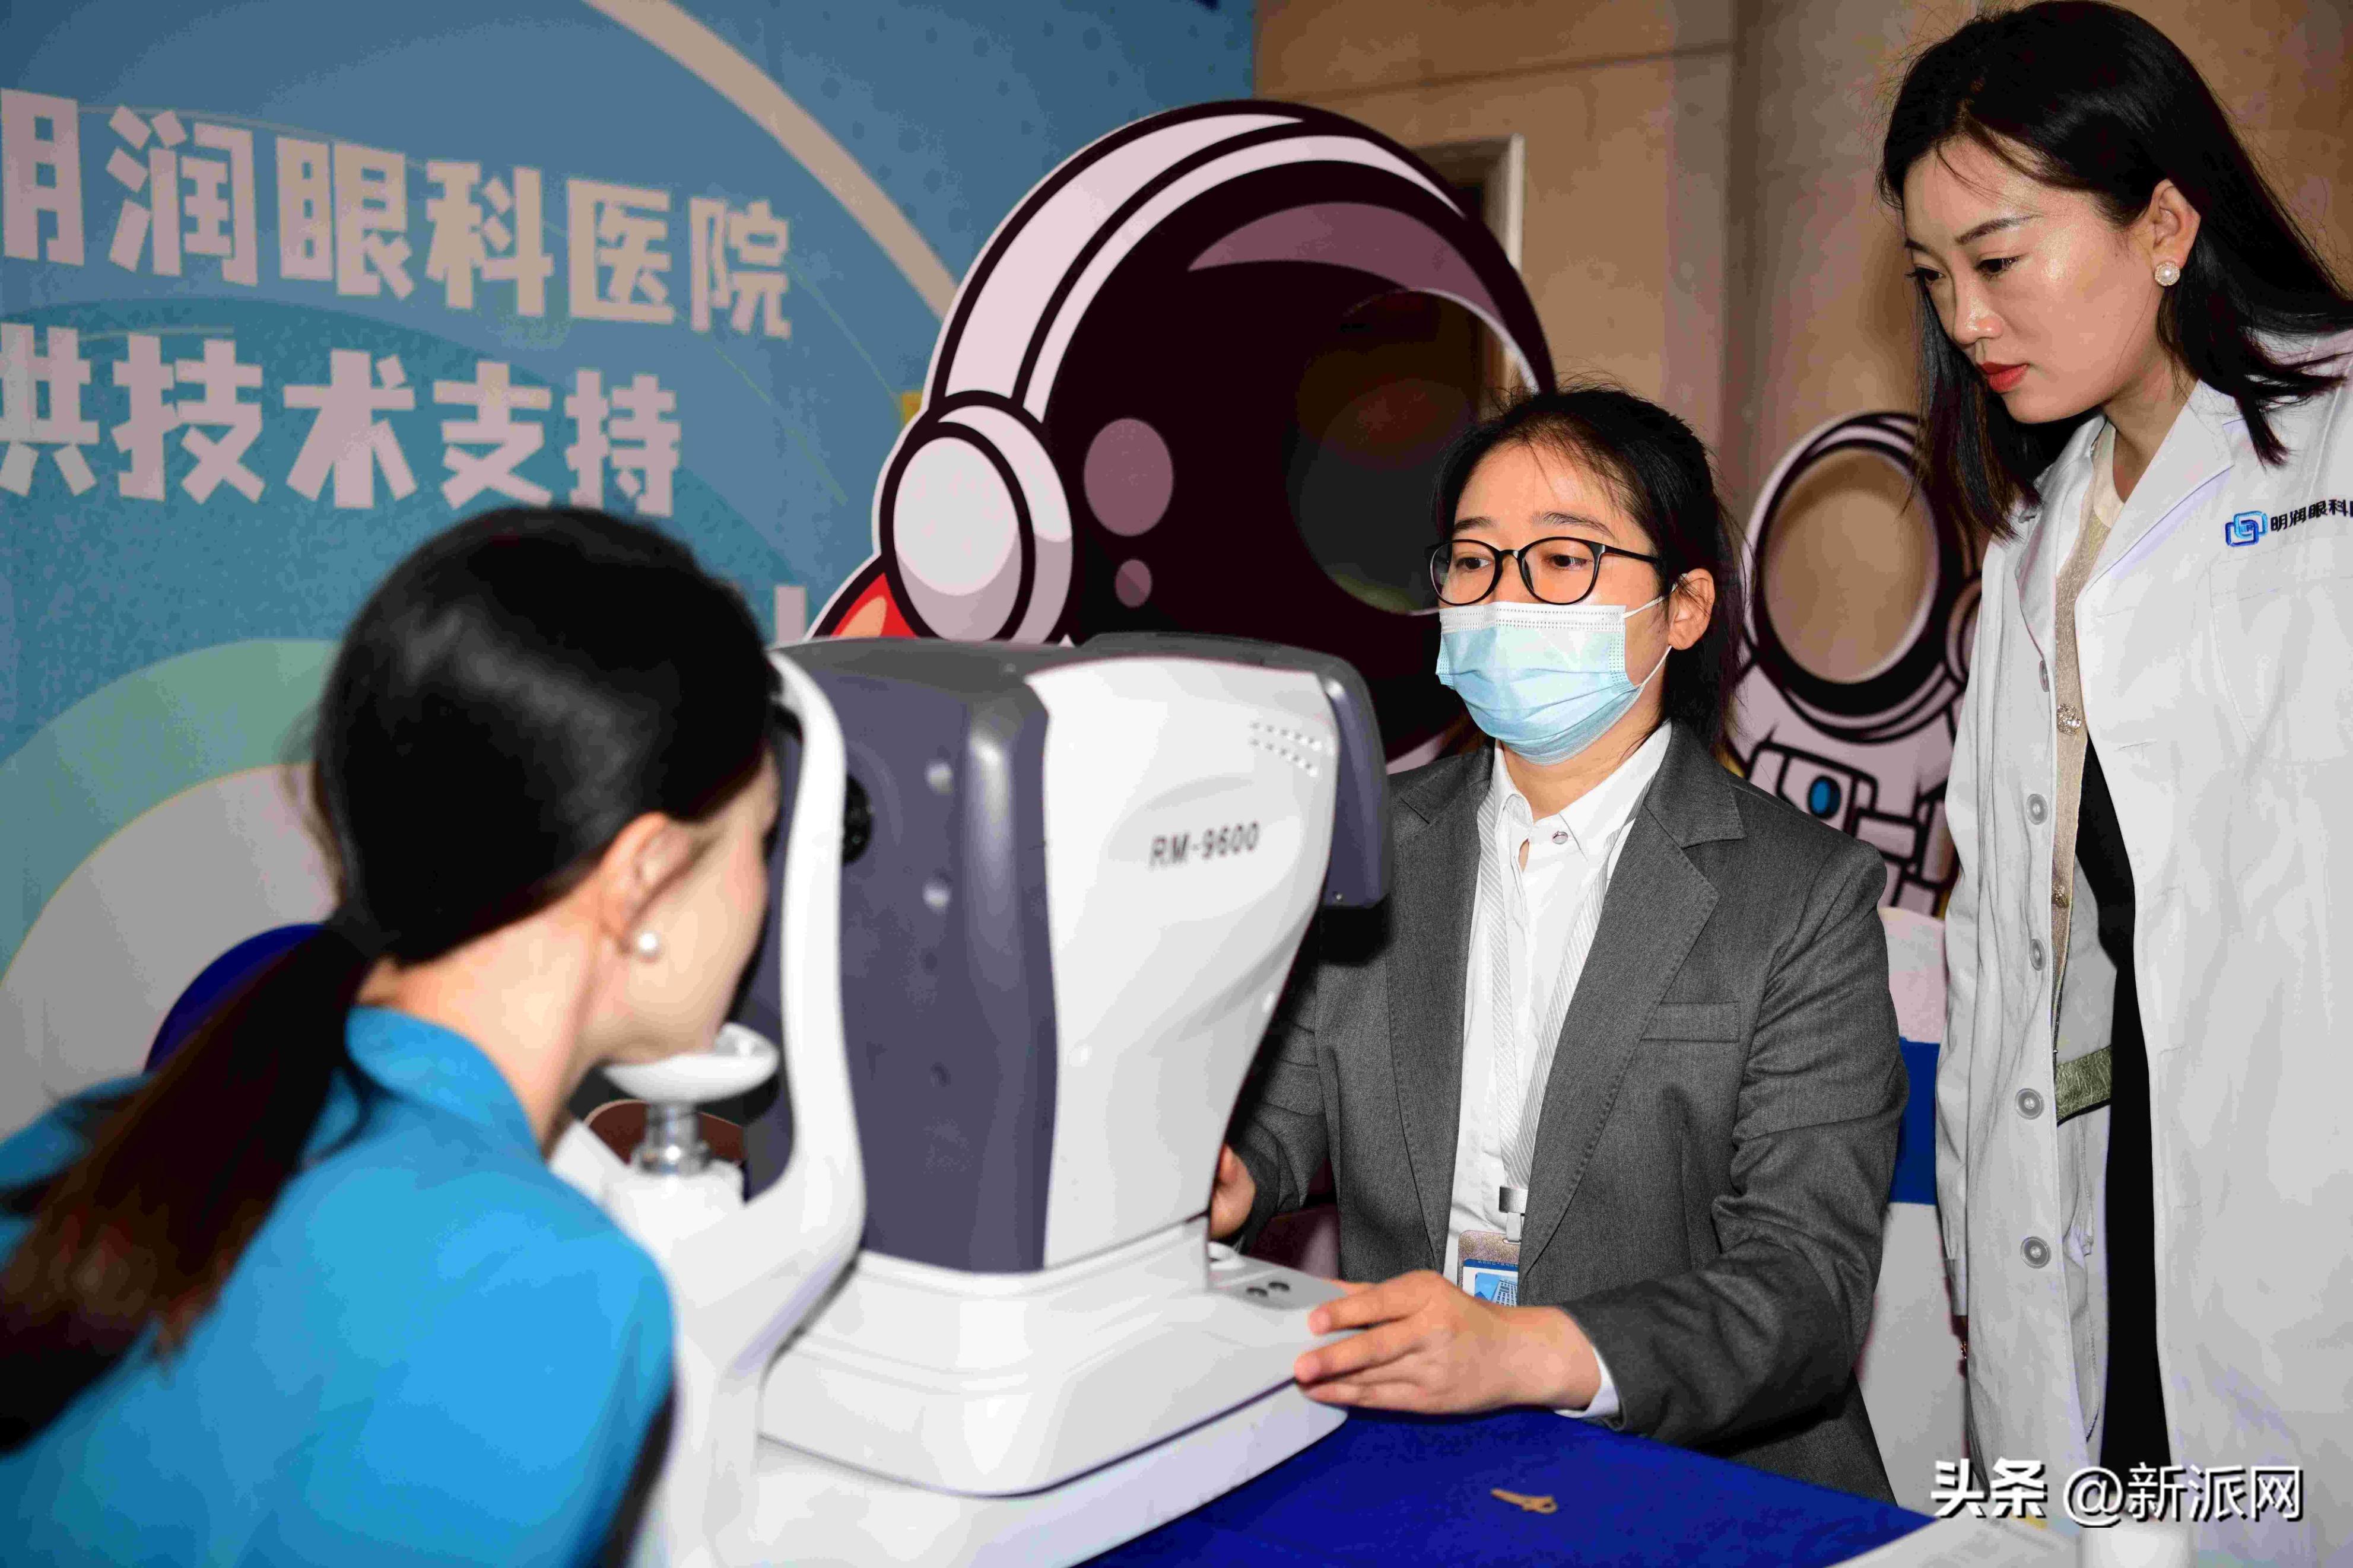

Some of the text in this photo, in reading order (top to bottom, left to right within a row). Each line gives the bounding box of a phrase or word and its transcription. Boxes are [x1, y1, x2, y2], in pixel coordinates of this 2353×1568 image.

[2271, 499, 2353, 532] 明润眼科
[1149, 820, 1260, 870] RM-9600
